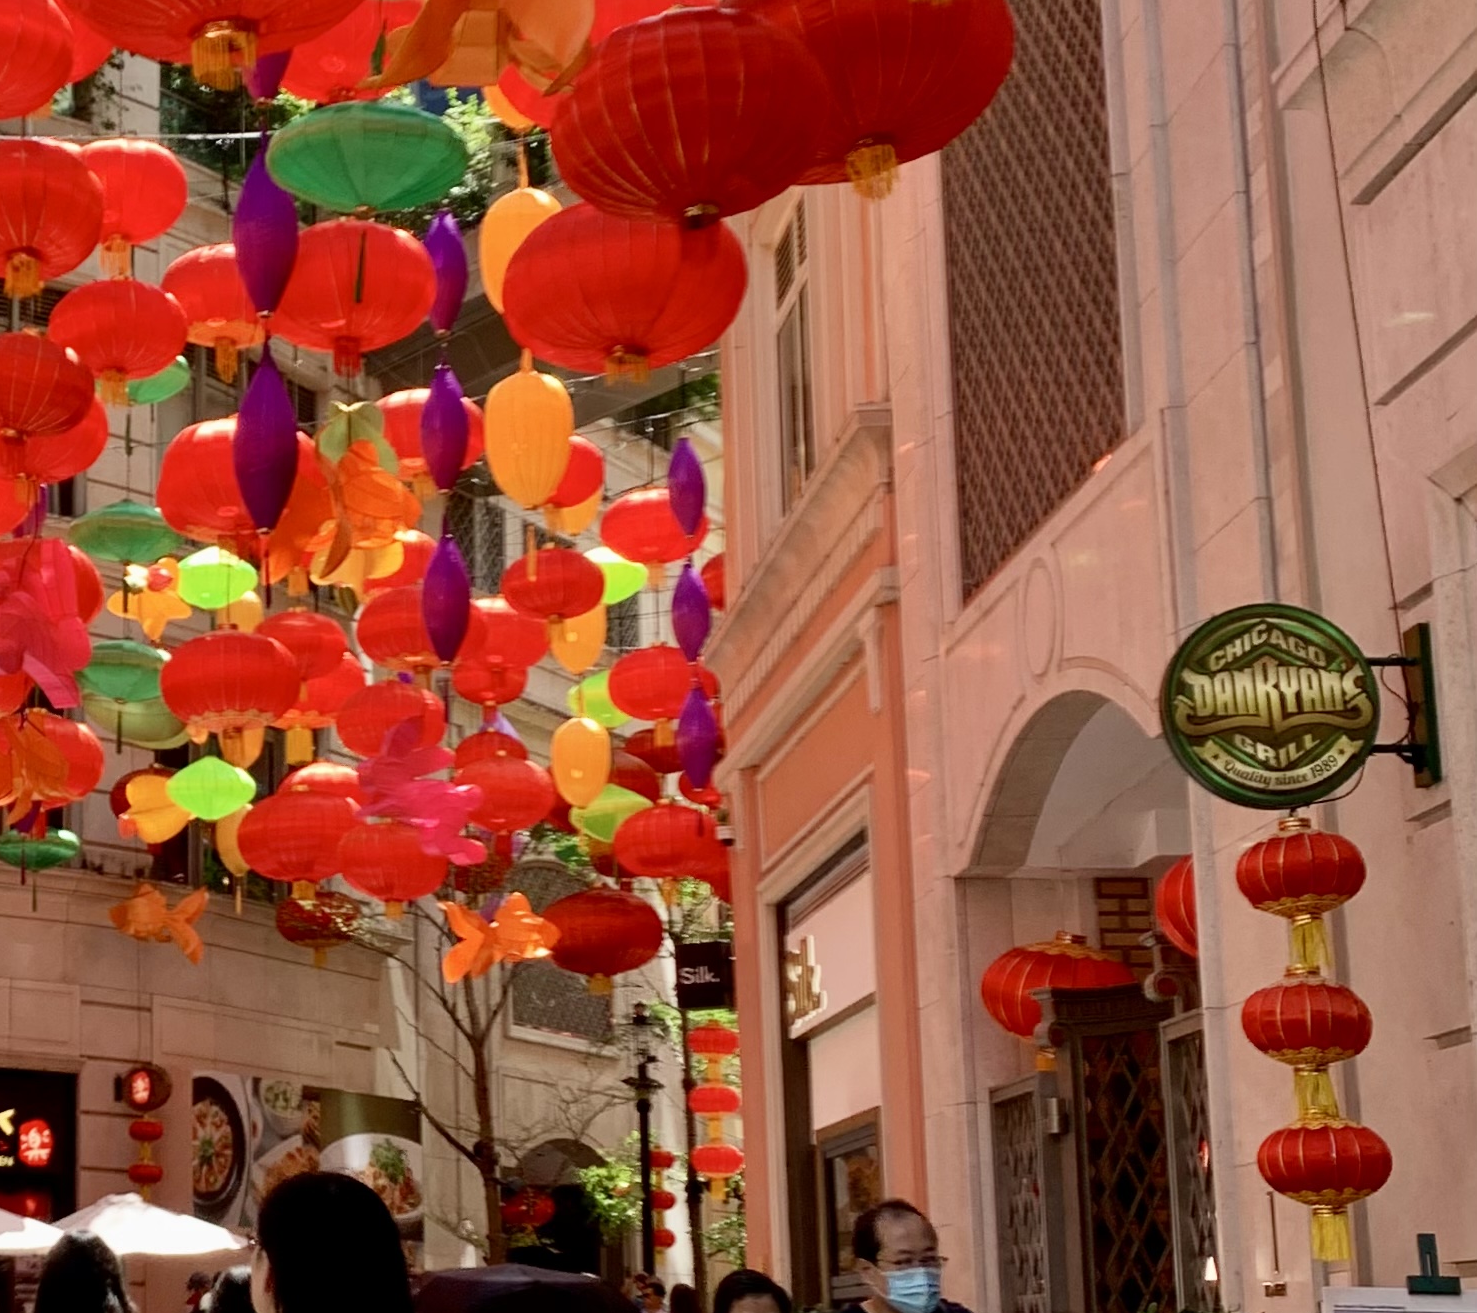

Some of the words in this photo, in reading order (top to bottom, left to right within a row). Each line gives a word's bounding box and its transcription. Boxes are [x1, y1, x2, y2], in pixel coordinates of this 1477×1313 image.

[1209, 624, 1326, 671] CHICAGO
[1233, 734, 1320, 768] GRILL
[1224, 759, 1273, 787] Quality
[1274, 773, 1309, 786] since
[1311, 754, 1338, 779] 1989
